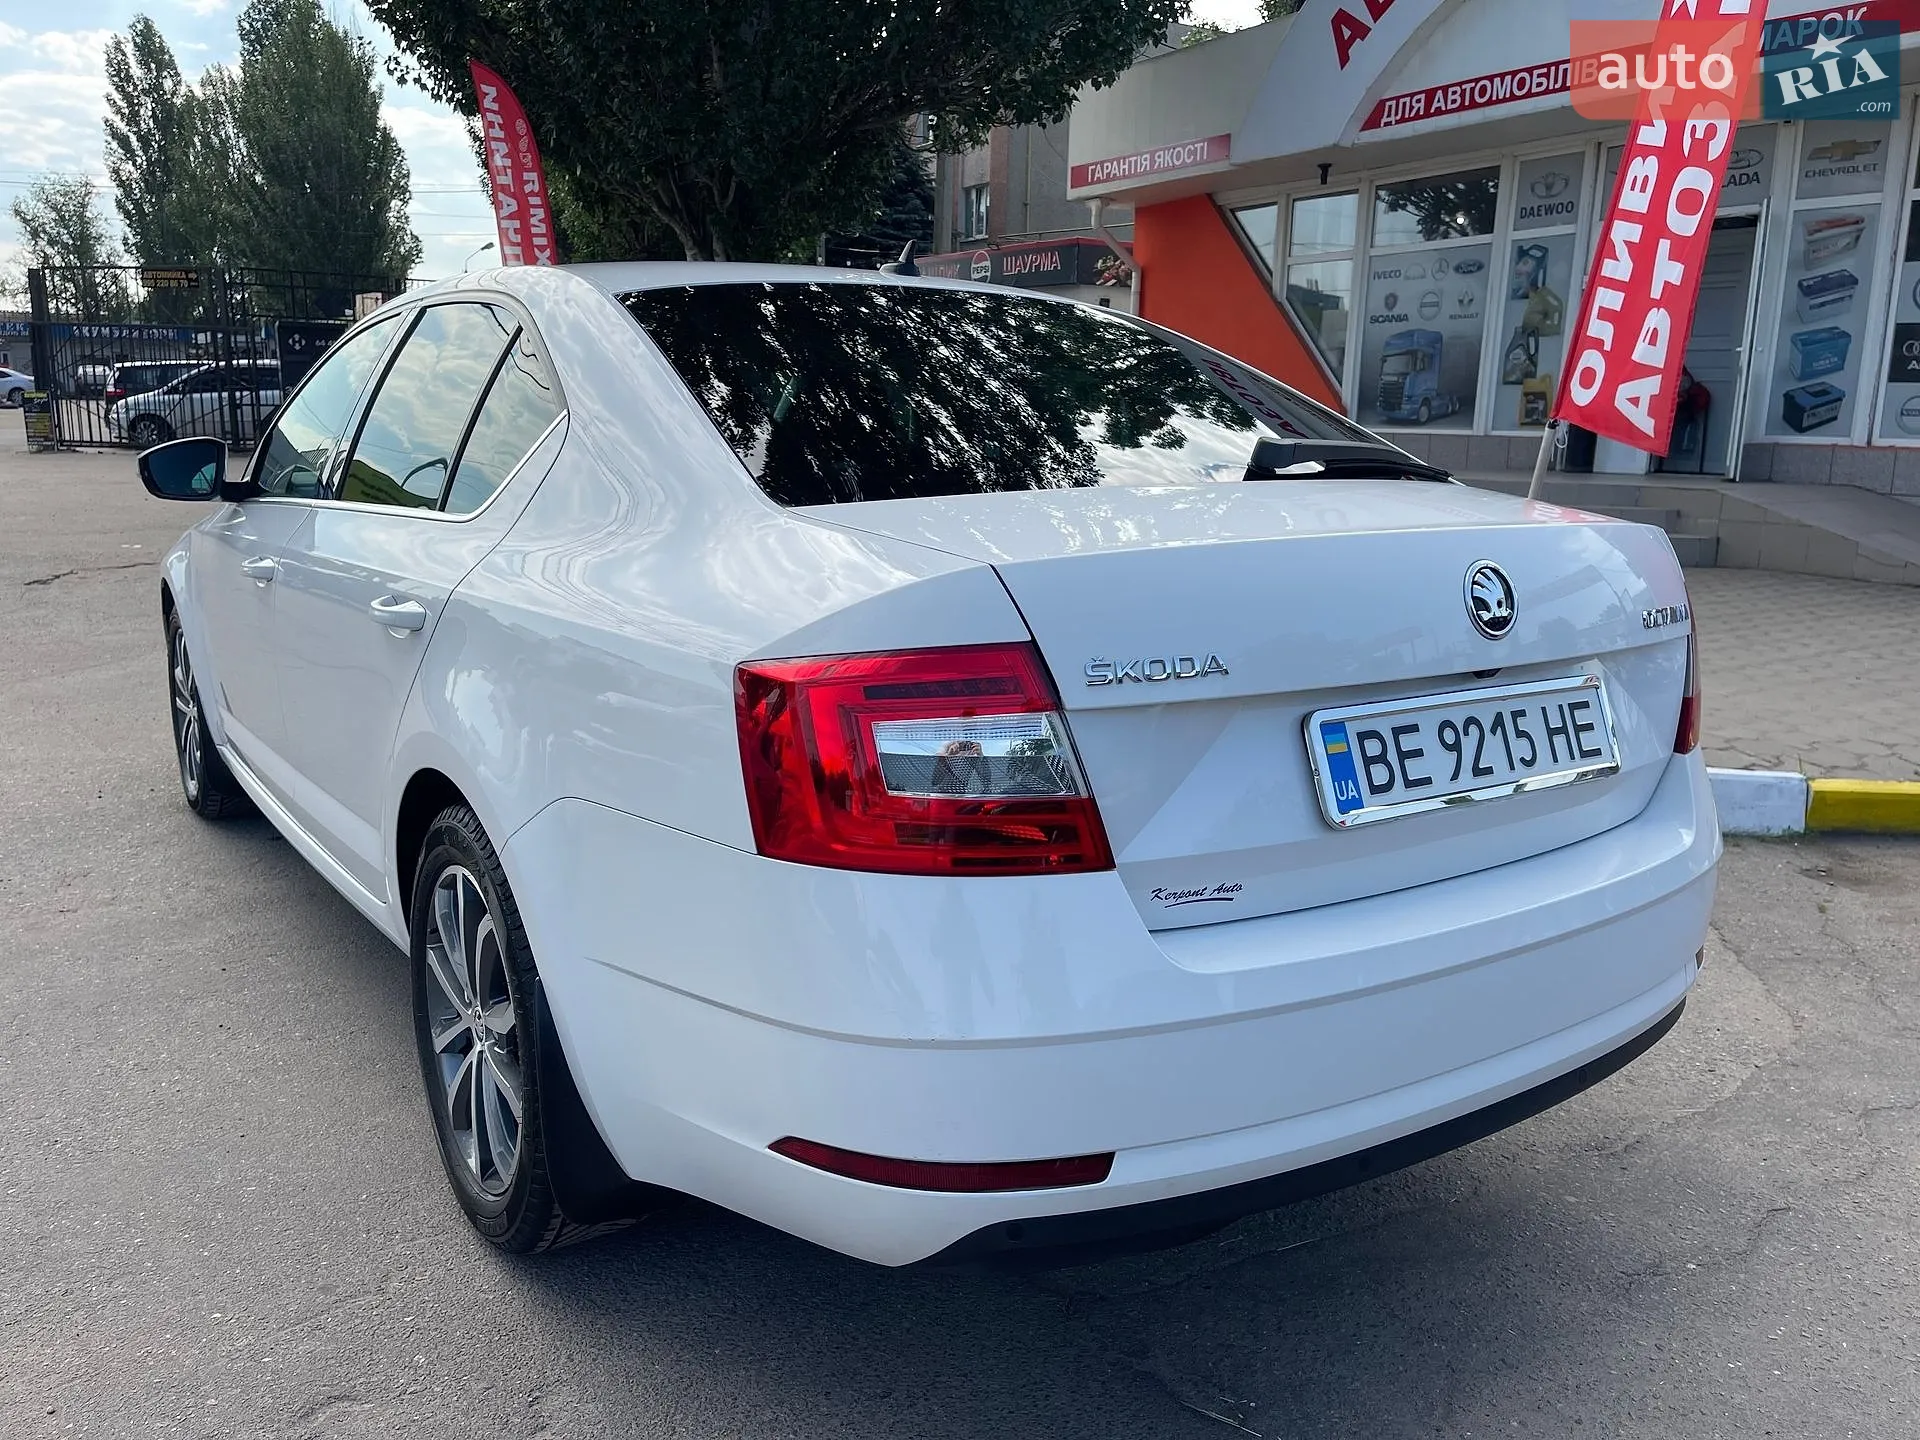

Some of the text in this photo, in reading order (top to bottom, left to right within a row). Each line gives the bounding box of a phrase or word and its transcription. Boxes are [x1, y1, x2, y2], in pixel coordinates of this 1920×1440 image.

[1380, 93, 1427, 127] ДЛЯ
[1430, 58, 1599, 113] АВТОМОБІЛІВ
[1087, 141, 1208, 183] ГАРАНТІЯ ЯКОСТІ
[1804, 162, 1879, 179] CHEVROLET
[1520, 200, 1575, 220] DAEWOO
[972, 263, 991, 275] PEPSI
[1002, 251, 1061, 276] ШАУРМА
[1373, 269, 1402, 281] IVECO
[1369, 313, 1409, 325] SCANIA
[1083, 651, 1230, 688] ŠKODA
[1357, 700, 1602, 795] BE 9215 HE
[1334, 778, 1359, 802] UA
[1150, 882, 1244, 902] Kerpont Auto
